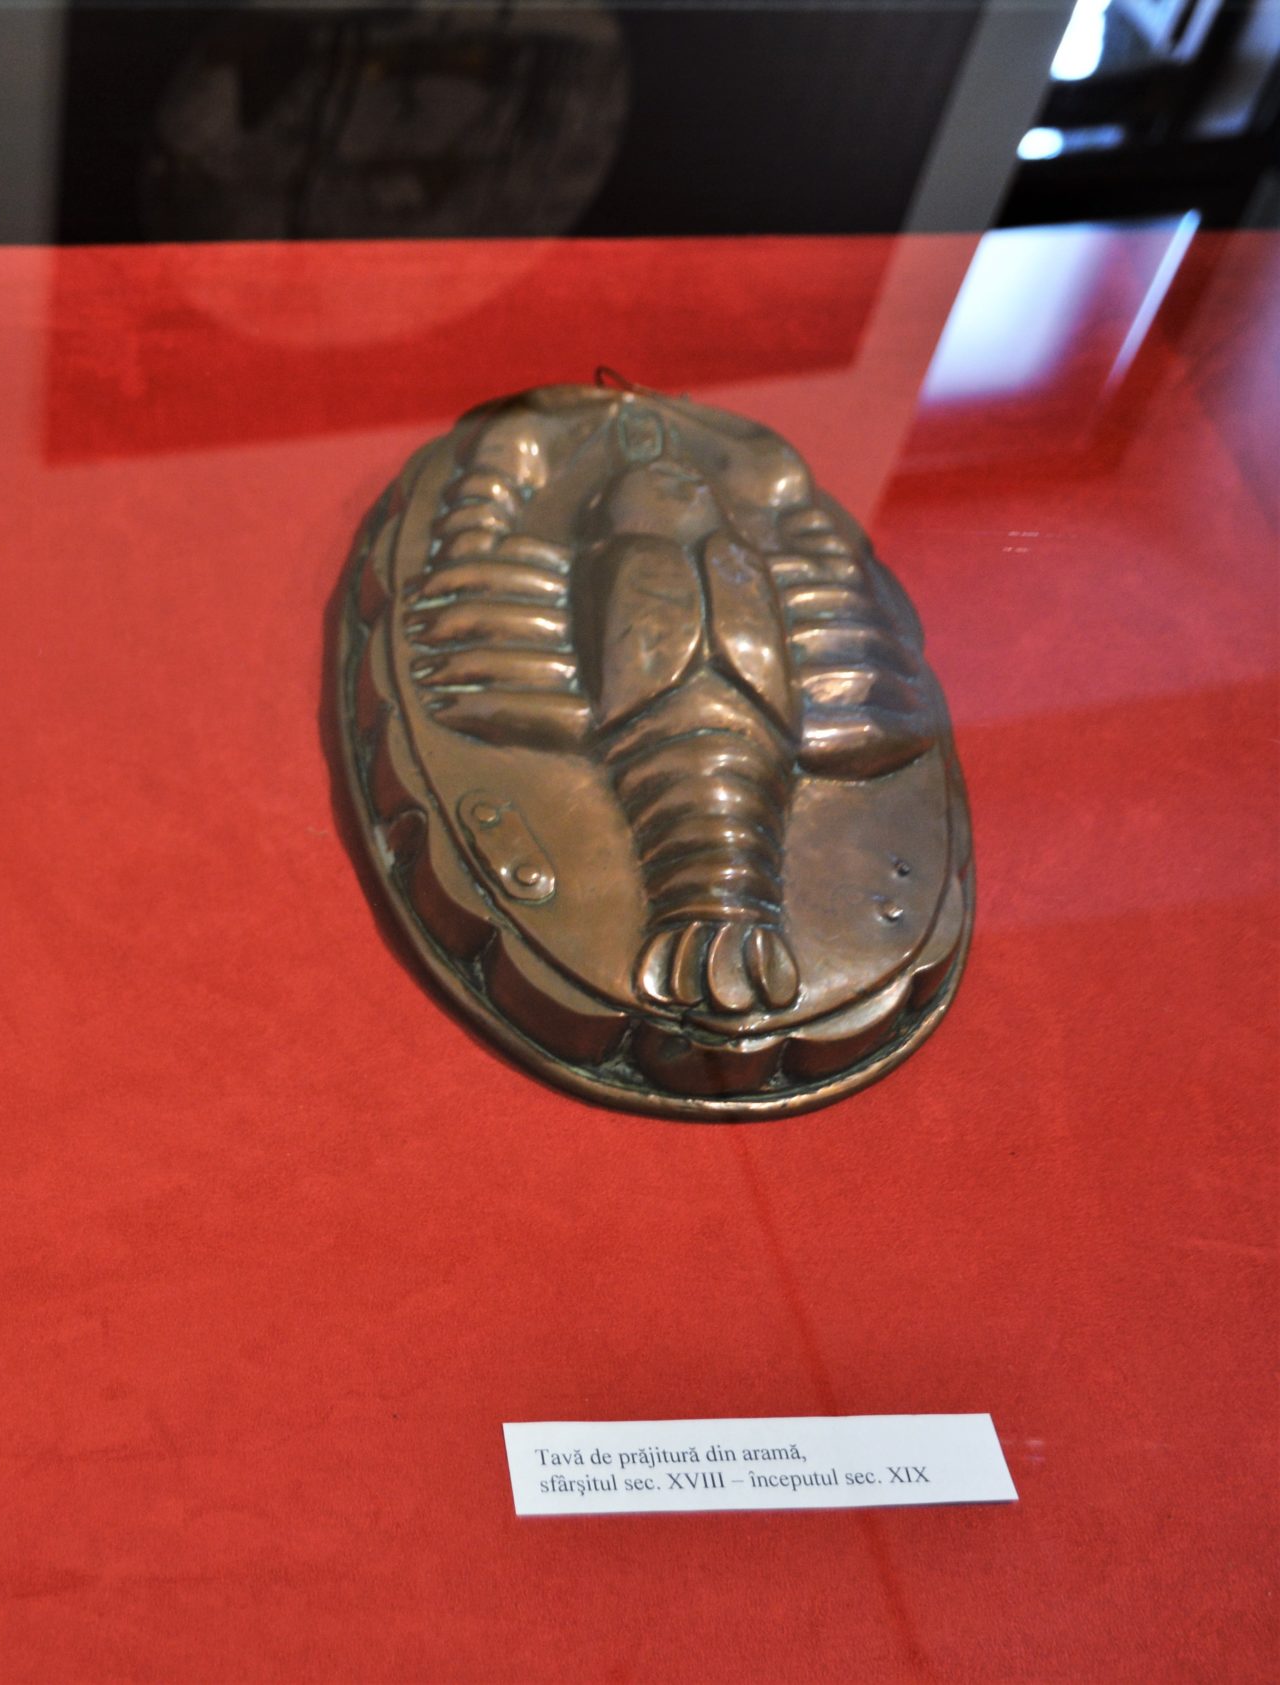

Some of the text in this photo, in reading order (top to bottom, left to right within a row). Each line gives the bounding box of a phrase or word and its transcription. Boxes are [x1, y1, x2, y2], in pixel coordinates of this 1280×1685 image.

[534, 1444, 808, 1469] Tavă de prăjitură din aramă,
[624, 1477, 662, 1491] sec.
[666, 1471, 726, 1491] XVIII
[748, 1468, 839, 1492] începutul
[844, 1472, 884, 1487] sec.
[887, 1465, 931, 1485] XIX
